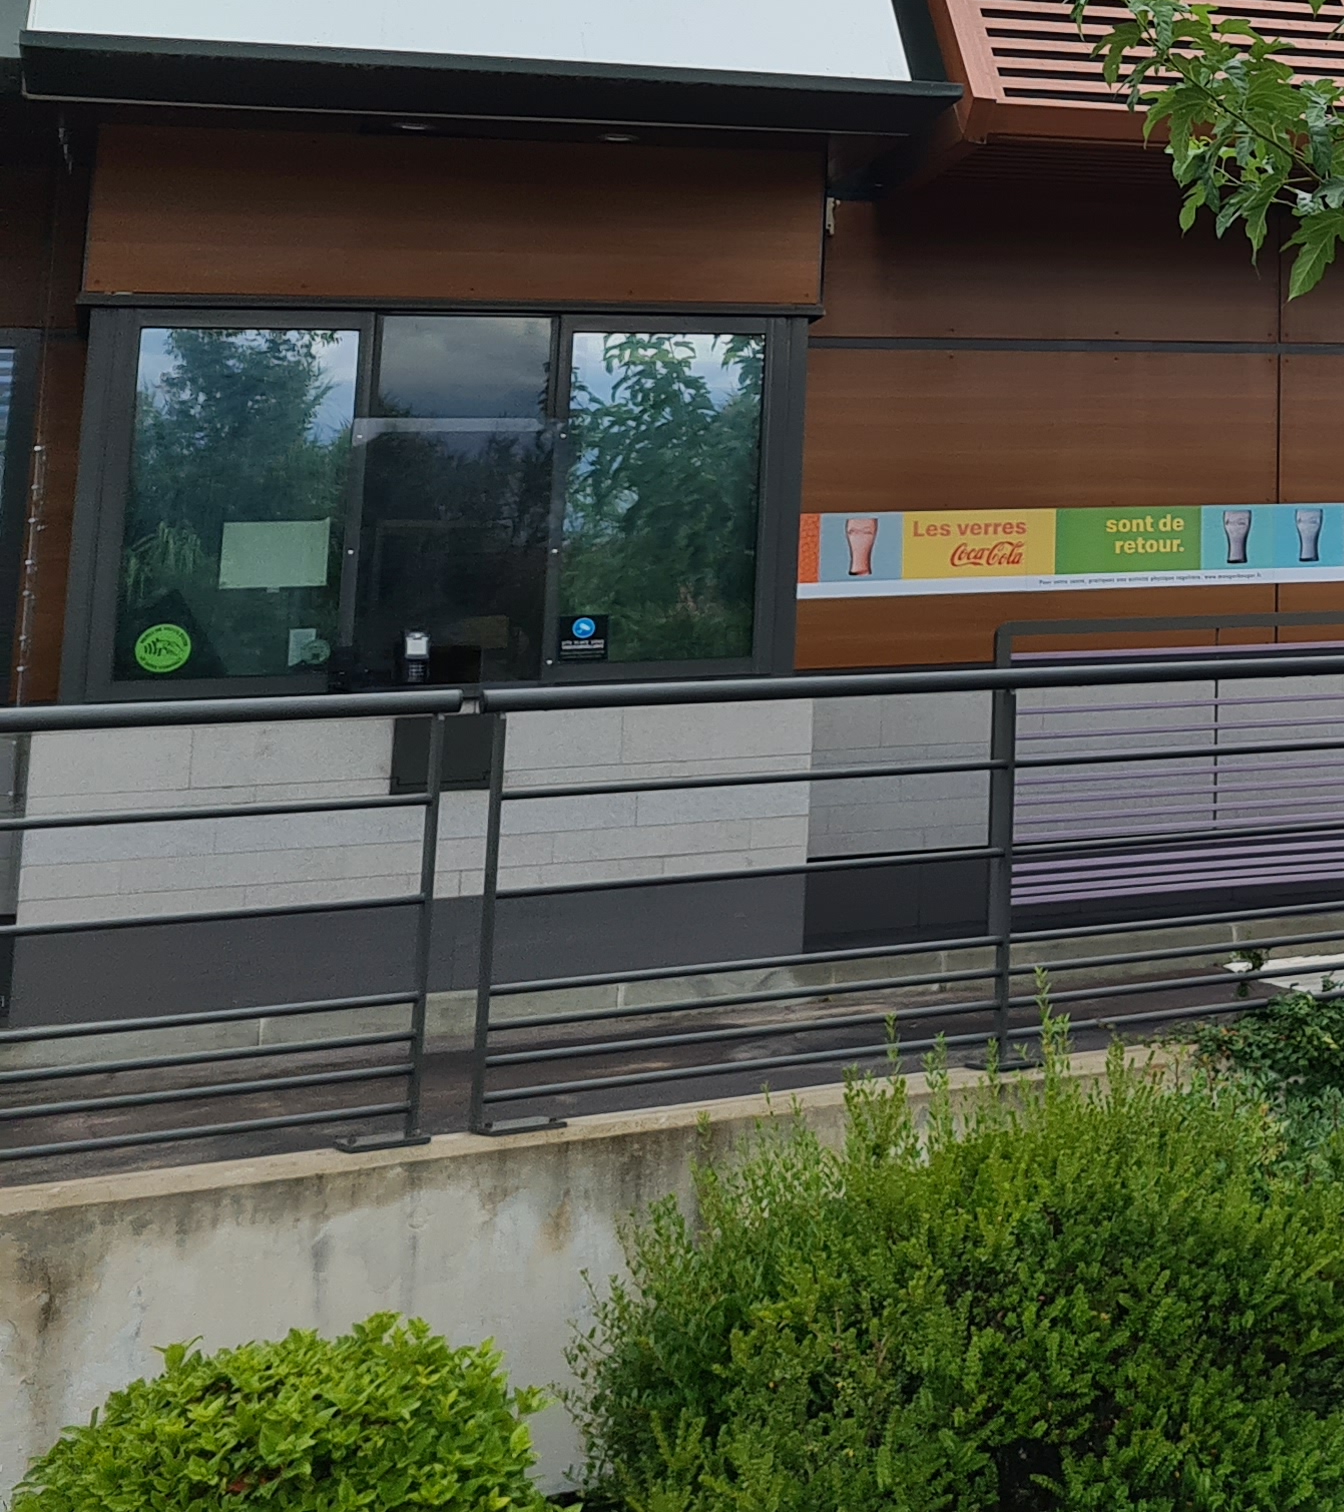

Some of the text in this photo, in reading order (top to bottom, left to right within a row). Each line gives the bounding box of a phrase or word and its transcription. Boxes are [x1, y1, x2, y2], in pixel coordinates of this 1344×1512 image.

[913, 520, 1027, 537] Les verres
[1106, 513, 1185, 533] sont de
[1114, 536, 1185, 555] retour.
